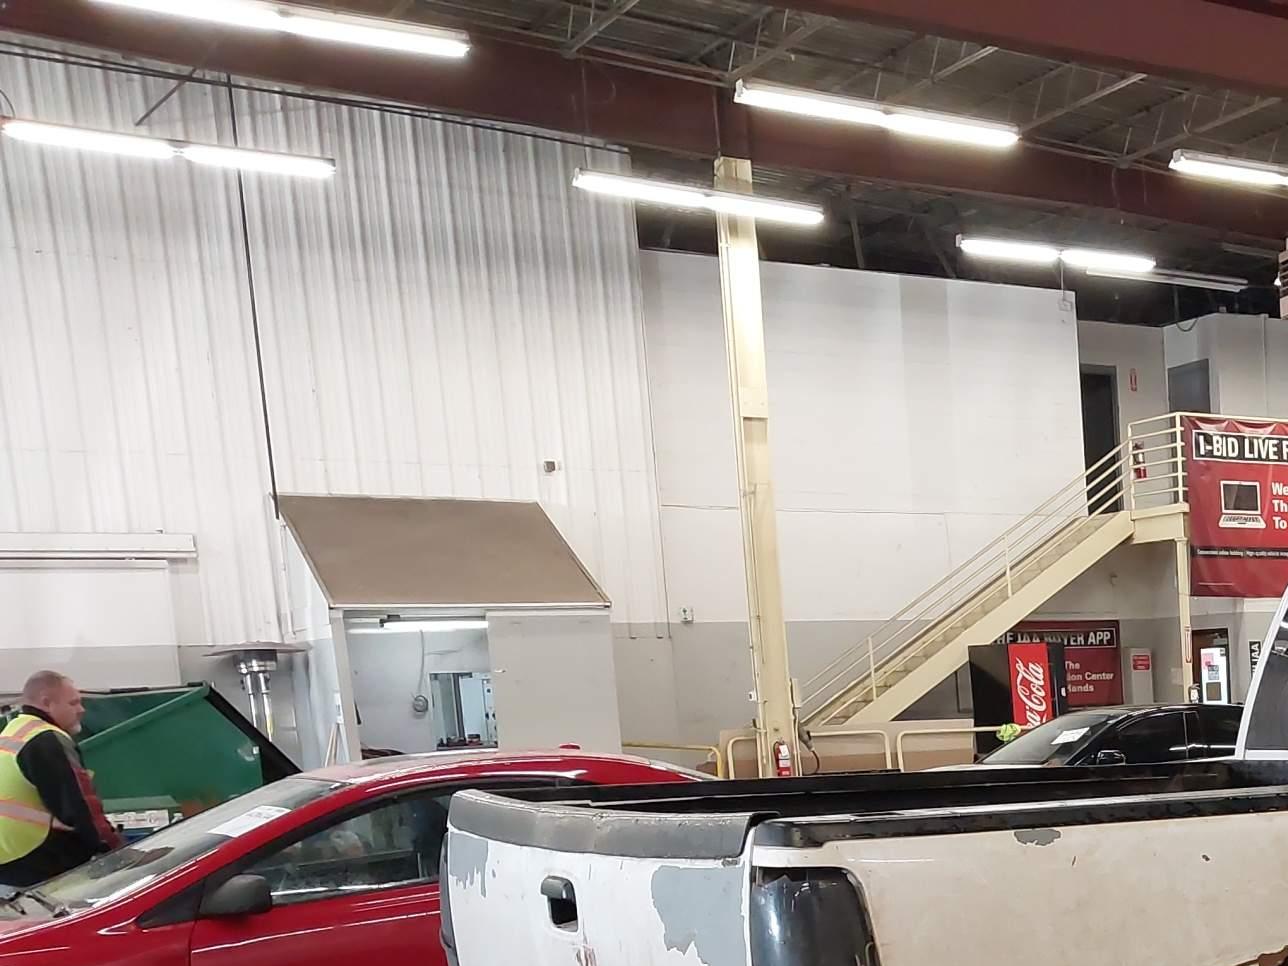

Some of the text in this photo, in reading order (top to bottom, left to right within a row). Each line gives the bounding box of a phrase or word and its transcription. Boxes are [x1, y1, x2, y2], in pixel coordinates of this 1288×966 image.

[1199, 435, 1239, 457] I-BID
[1244, 438, 1278, 460] LIVE
[1272, 517, 1287, 529] To
[1088, 632, 1111, 645] APP
[1085, 672, 1114, 680] Center
